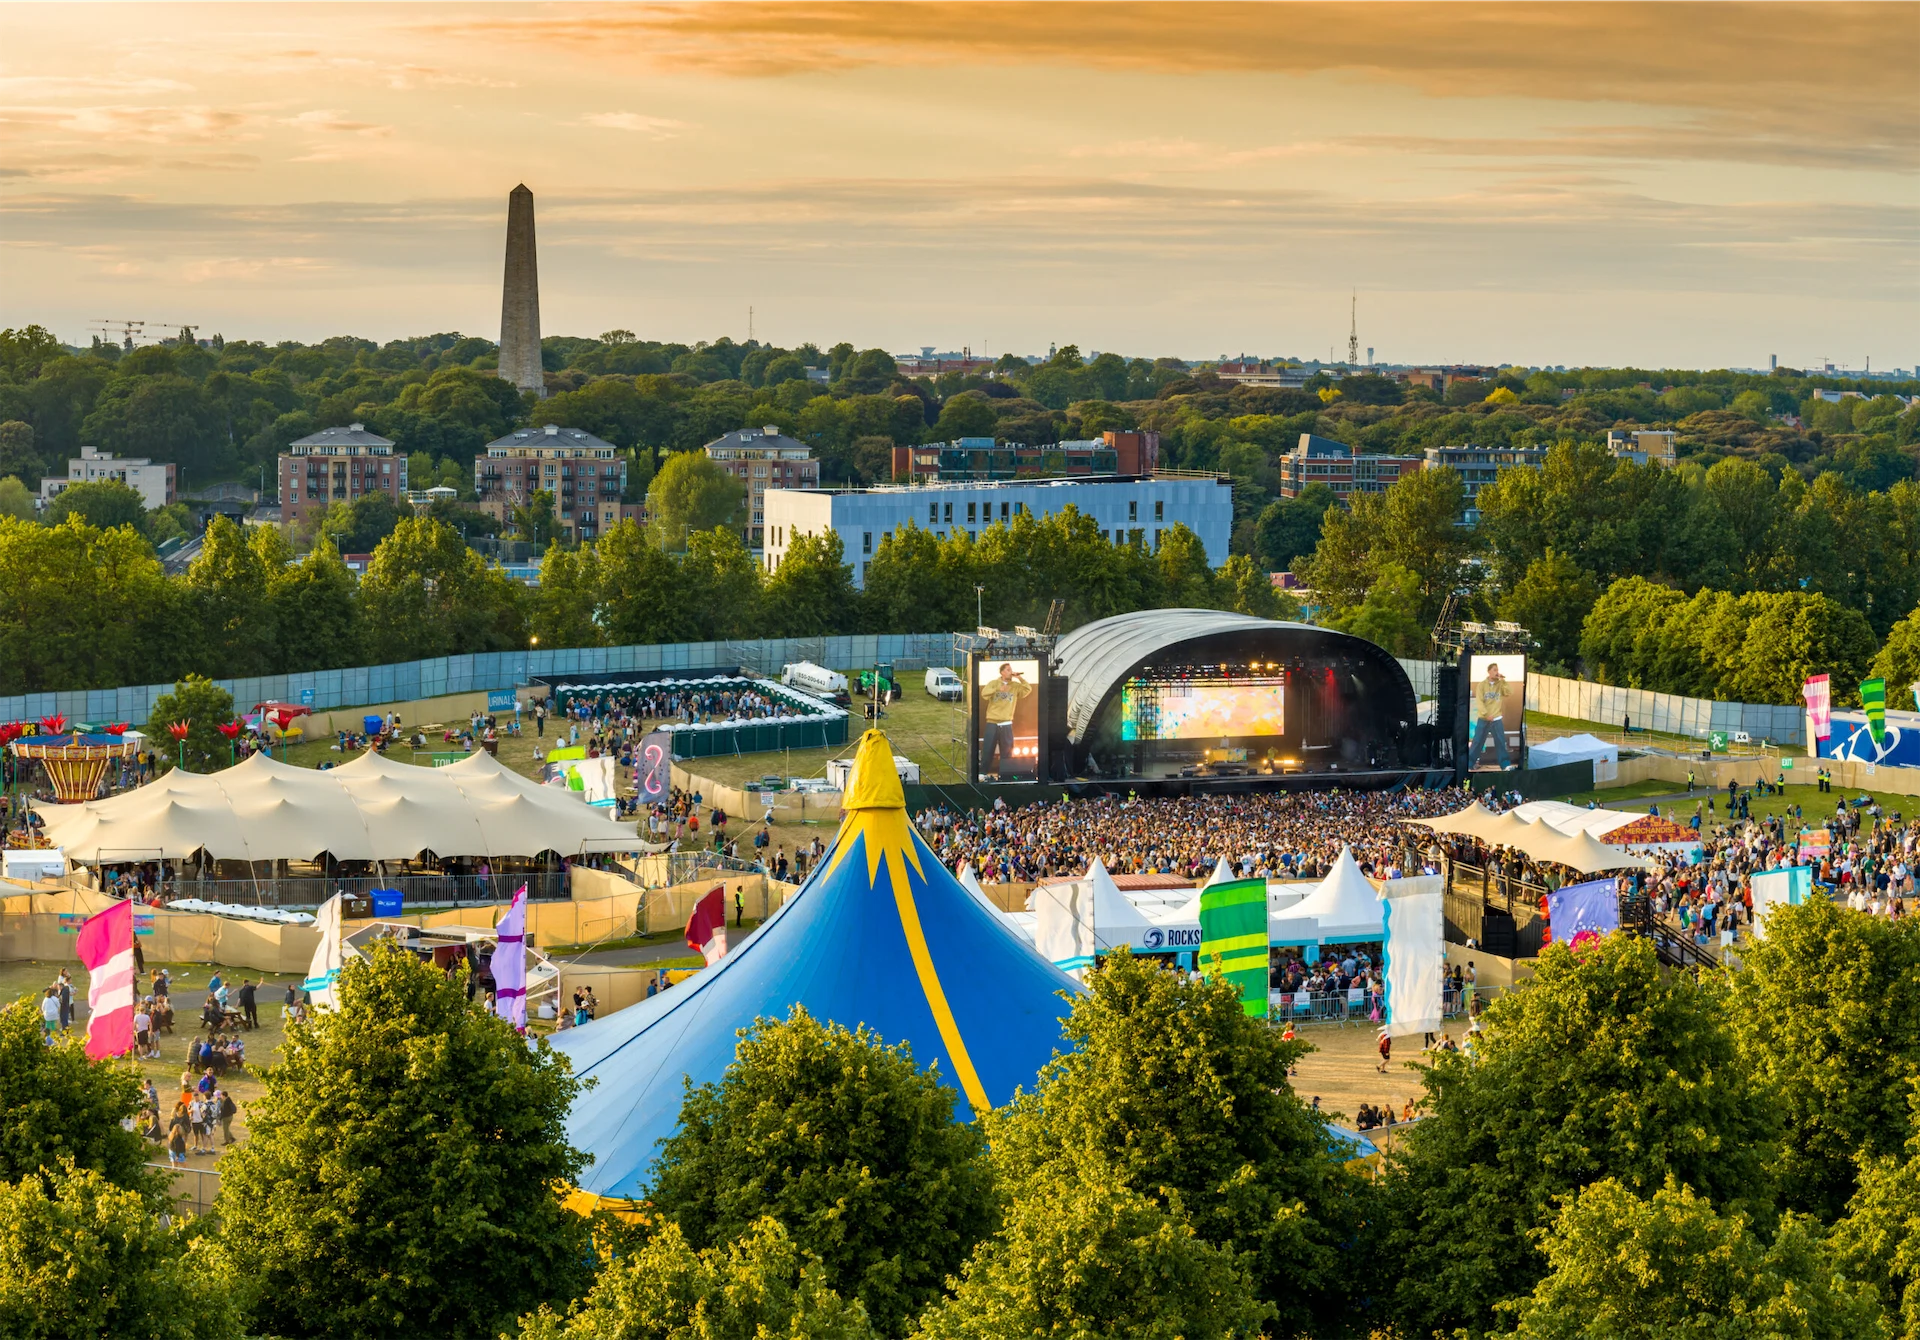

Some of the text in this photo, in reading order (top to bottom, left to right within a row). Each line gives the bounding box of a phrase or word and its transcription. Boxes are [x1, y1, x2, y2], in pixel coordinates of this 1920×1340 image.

[488, 694, 516, 707] URINALS
[1781, 758, 1793, 766] EXIT
[1624, 826, 1677, 835] MERCHANDISE
